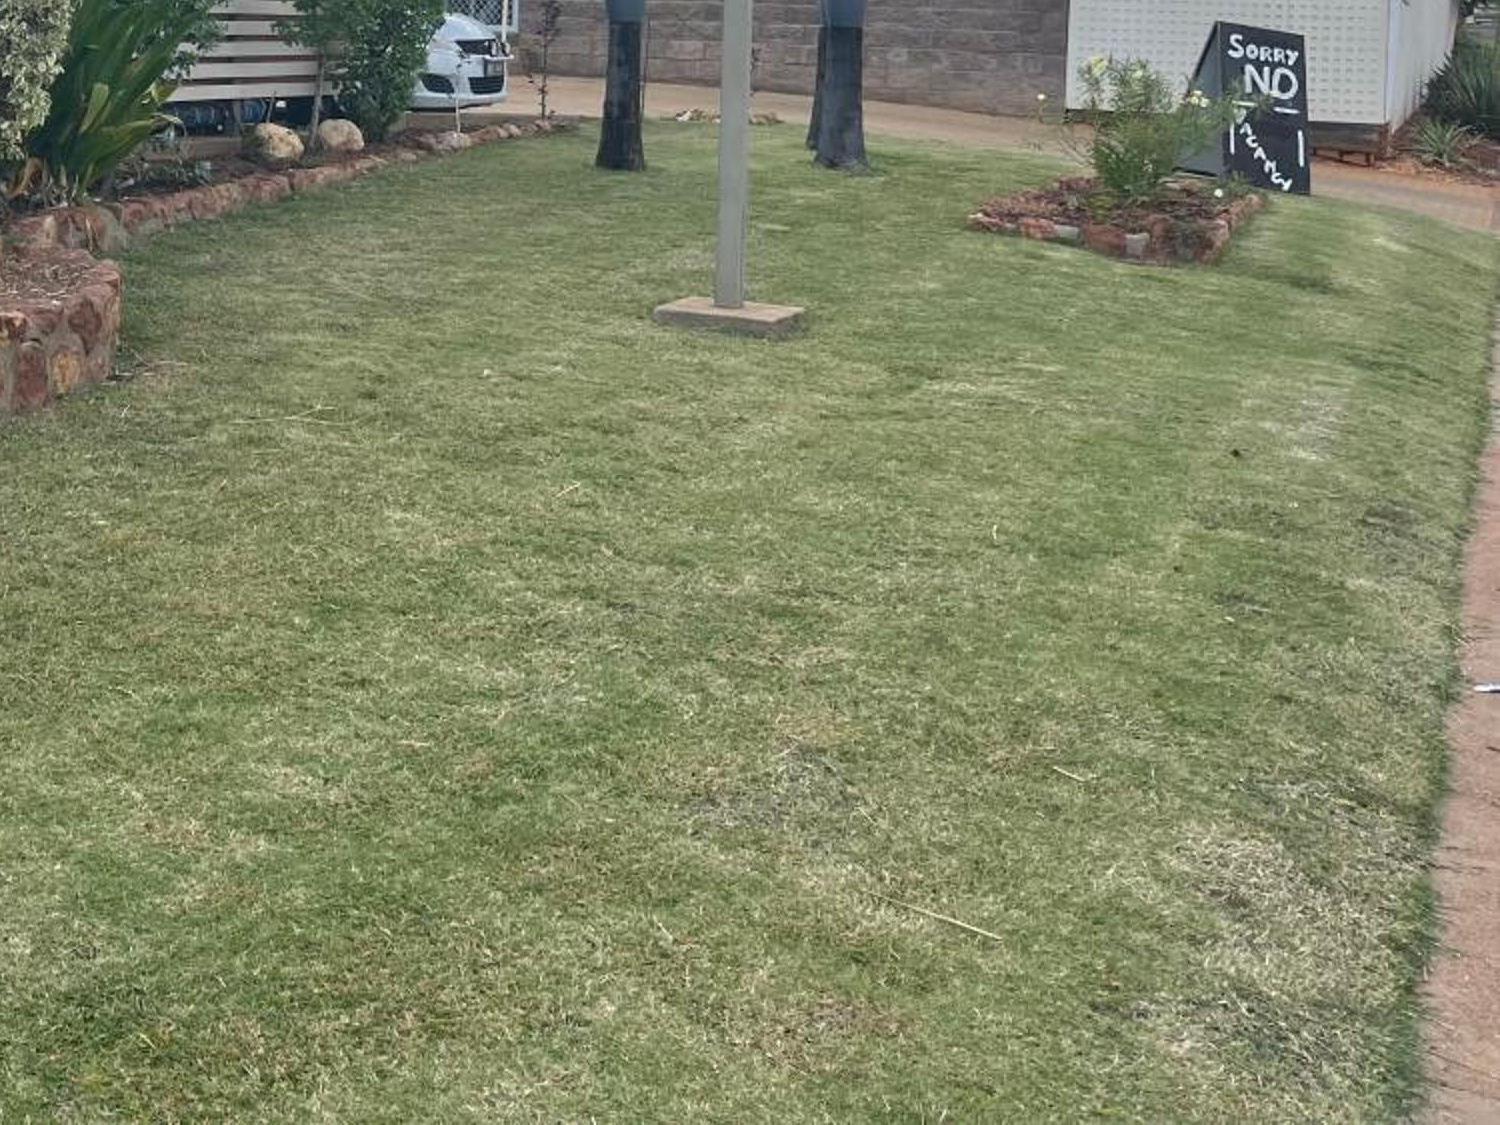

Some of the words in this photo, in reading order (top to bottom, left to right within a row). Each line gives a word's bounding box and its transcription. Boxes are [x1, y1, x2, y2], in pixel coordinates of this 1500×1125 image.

[1228, 33, 1299, 66] SORRY
[1243, 63, 1299, 100] NO
[1233, 107, 1292, 192] VACANCY
